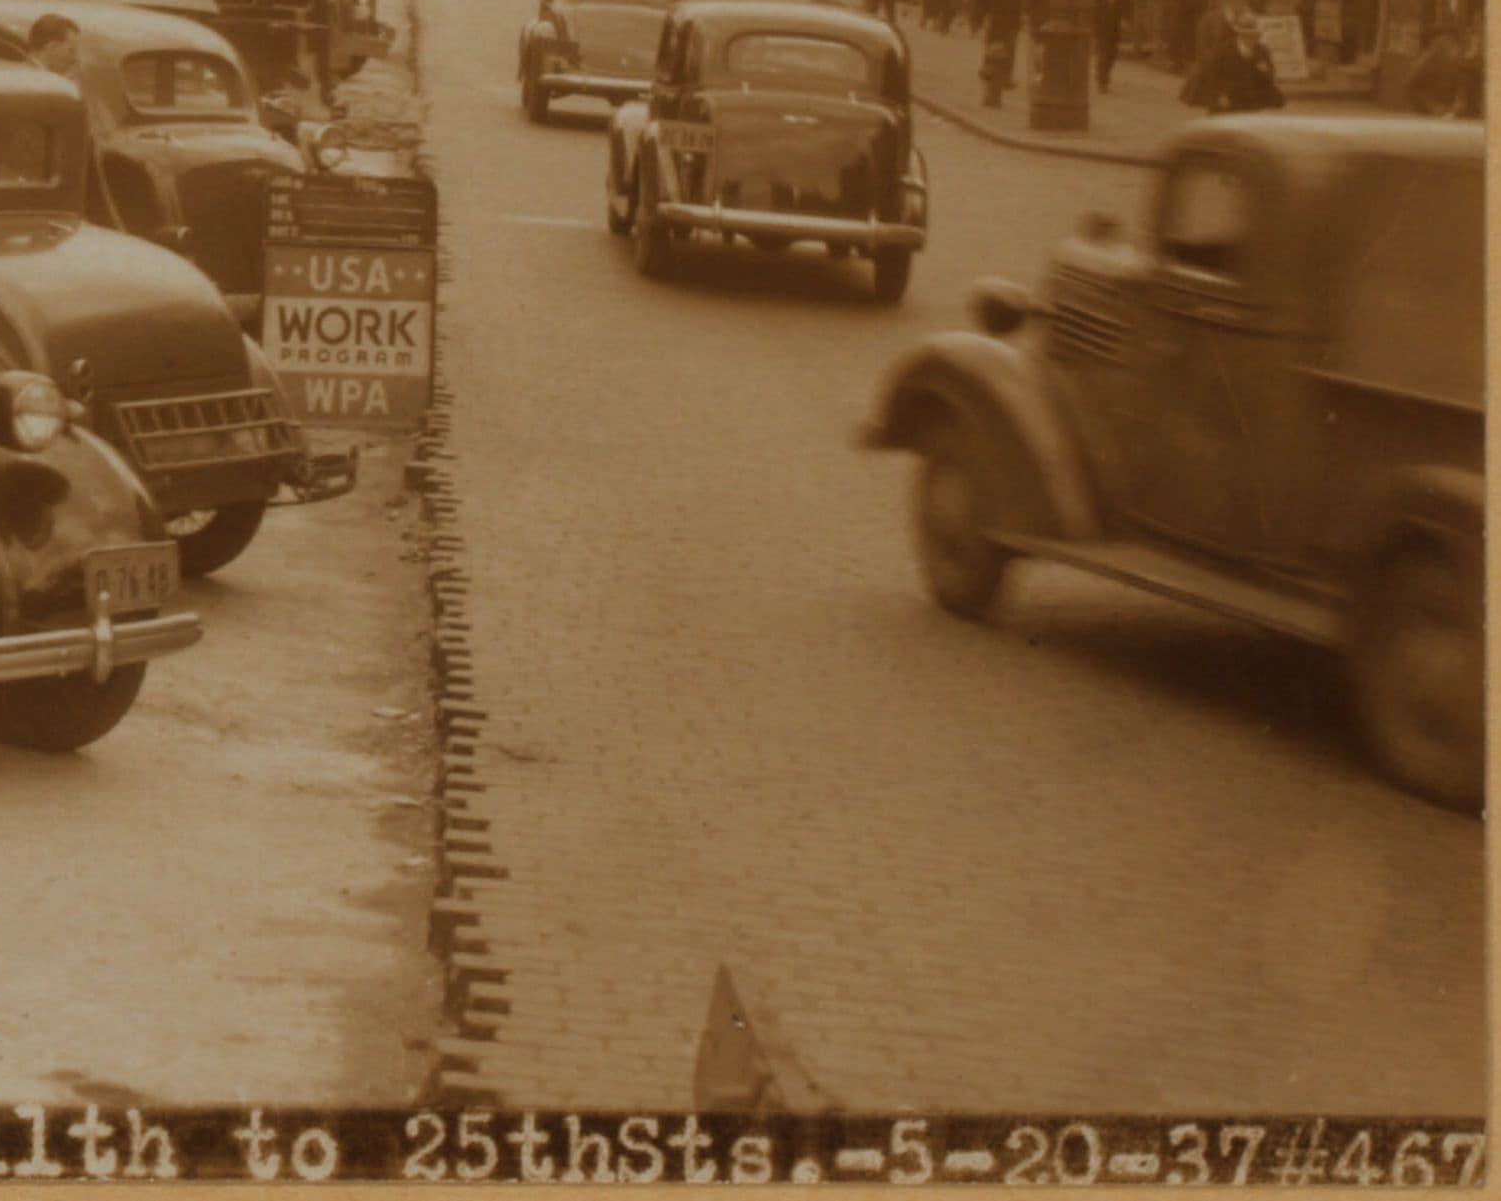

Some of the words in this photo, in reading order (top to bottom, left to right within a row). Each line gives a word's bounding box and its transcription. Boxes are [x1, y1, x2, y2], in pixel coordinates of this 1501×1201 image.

[309, 255, 392, 294] USA
[278, 305, 417, 347] WORK
[280, 347, 412, 365] PROGRAM
[304, 378, 390, 415] WPA
